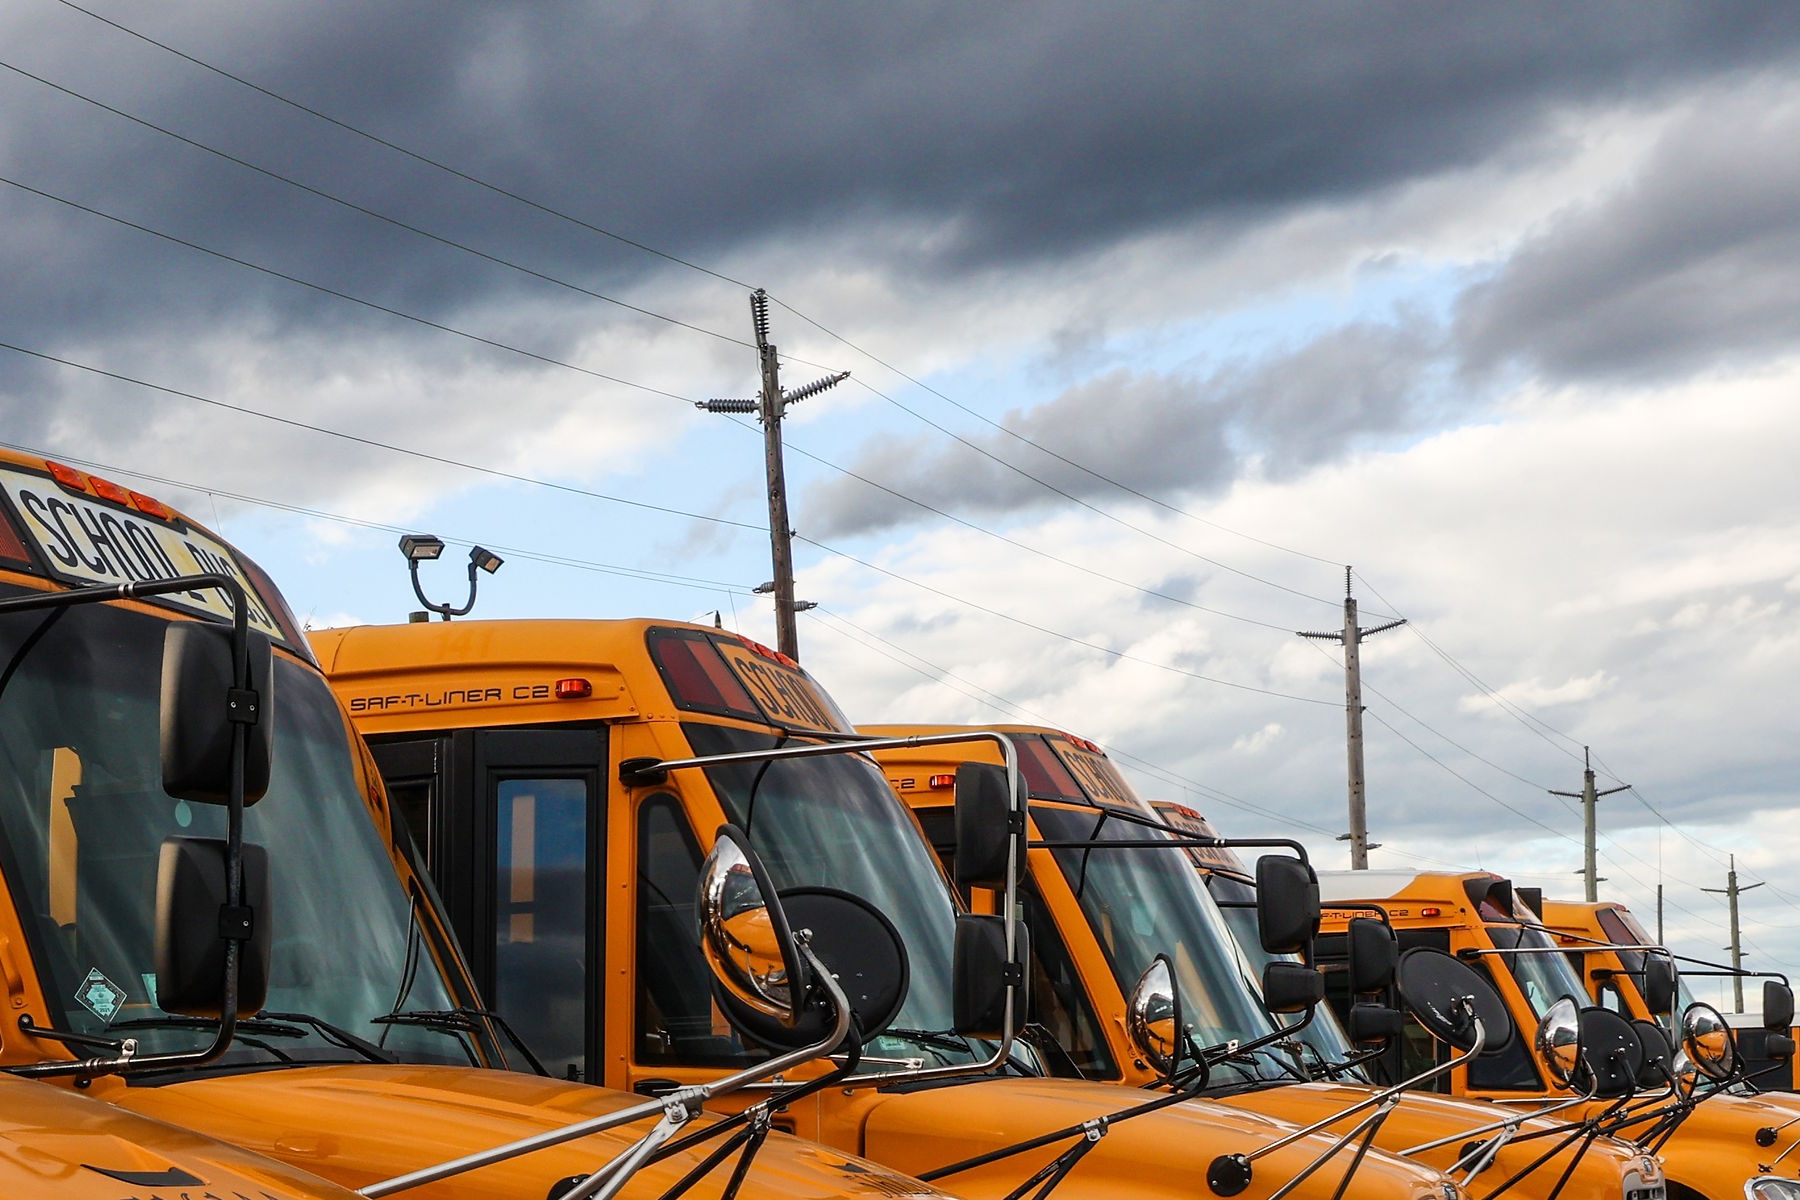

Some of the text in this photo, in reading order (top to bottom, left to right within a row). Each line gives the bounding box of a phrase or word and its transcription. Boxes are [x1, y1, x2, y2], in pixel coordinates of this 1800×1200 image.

[19, 489, 207, 604] SCHOOL
[350, 685, 549, 711] SAF-T-LINER C2
